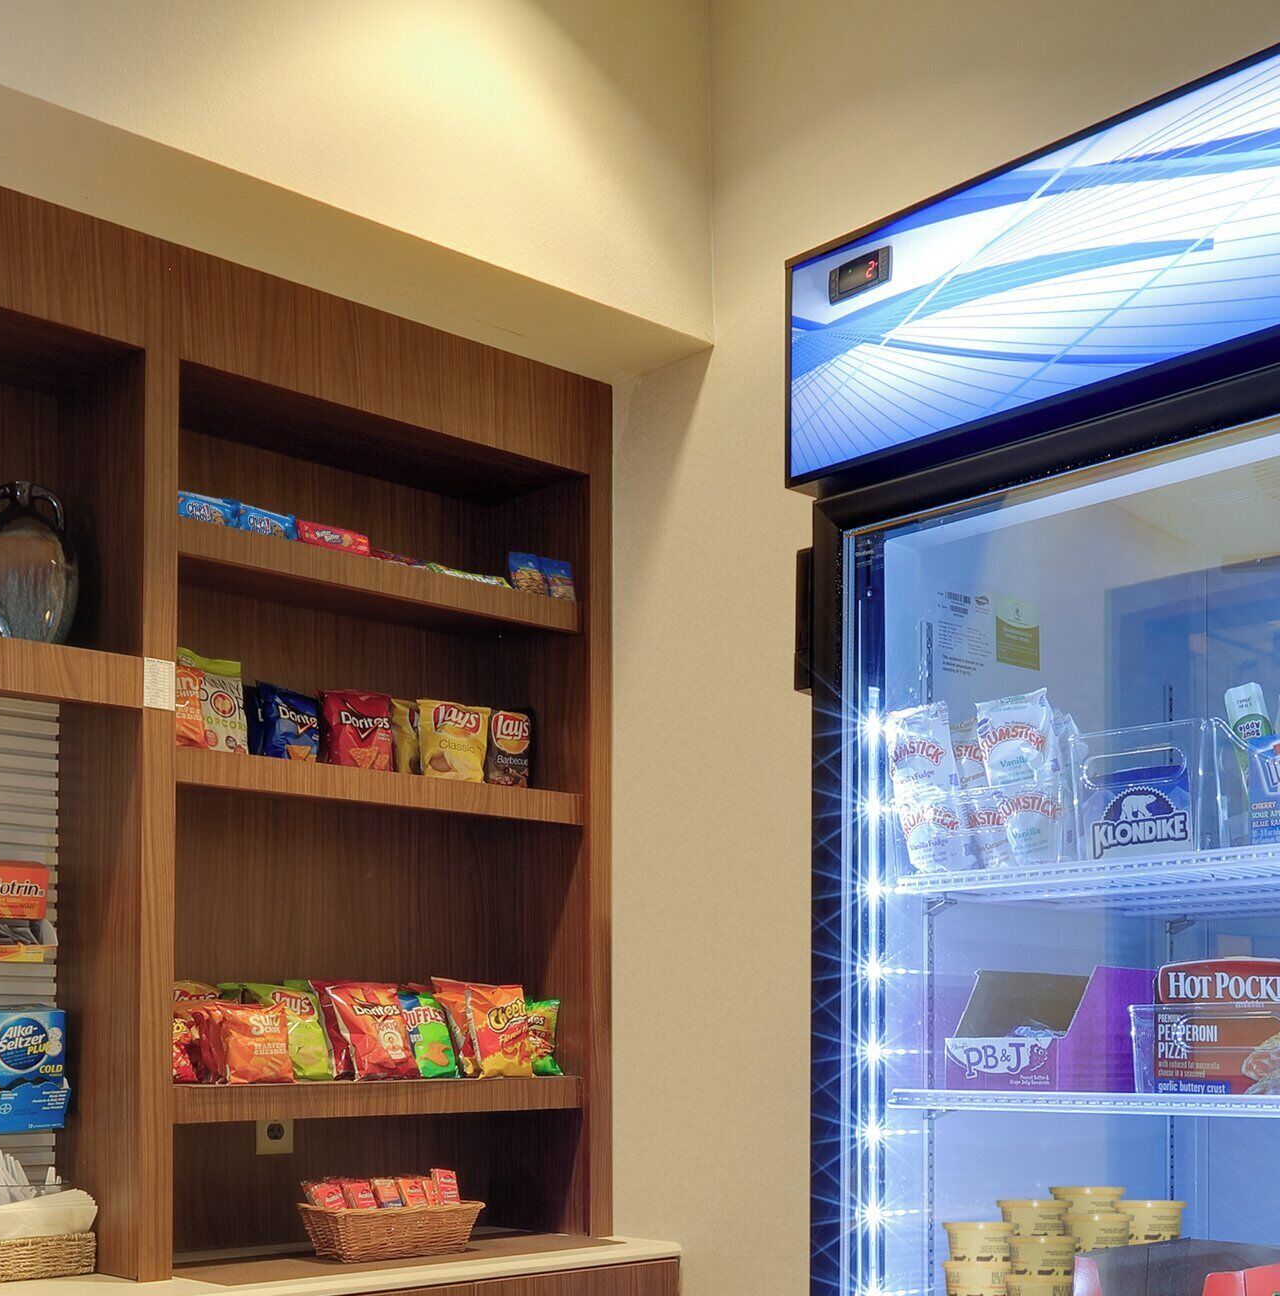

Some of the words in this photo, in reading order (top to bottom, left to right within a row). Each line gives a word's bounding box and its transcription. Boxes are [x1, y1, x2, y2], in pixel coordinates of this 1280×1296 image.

[341, 711, 390, 729] Doritos
[438, 705, 479, 728] Lay's
[497, 715, 531, 741] Lay's
[439, 739, 475, 754] Classic
[497, 755, 528, 766] Barbecue
[1252, 802, 1276, 810] CHERRY
[1252, 821, 1269, 829] BLUE
[1094, 813, 1187, 858] KLONDIKE
[1168, 972, 1212, 999] HOT
[353, 1004, 400, 1016] Doritos
[2, 1025, 38, 1040] Alka-
[1158, 1024, 1217, 1042] PEPPERONI
[1158, 1042, 1188, 1059] PIZZA
[39, 1064, 63, 1073] COLD
[964, 1042, 1026, 1079] PB&J
[1158, 1081, 1178, 1091] garlic
[1179, 1081, 1205, 1094] buttery
[1207, 1084, 1226, 1093] crust
